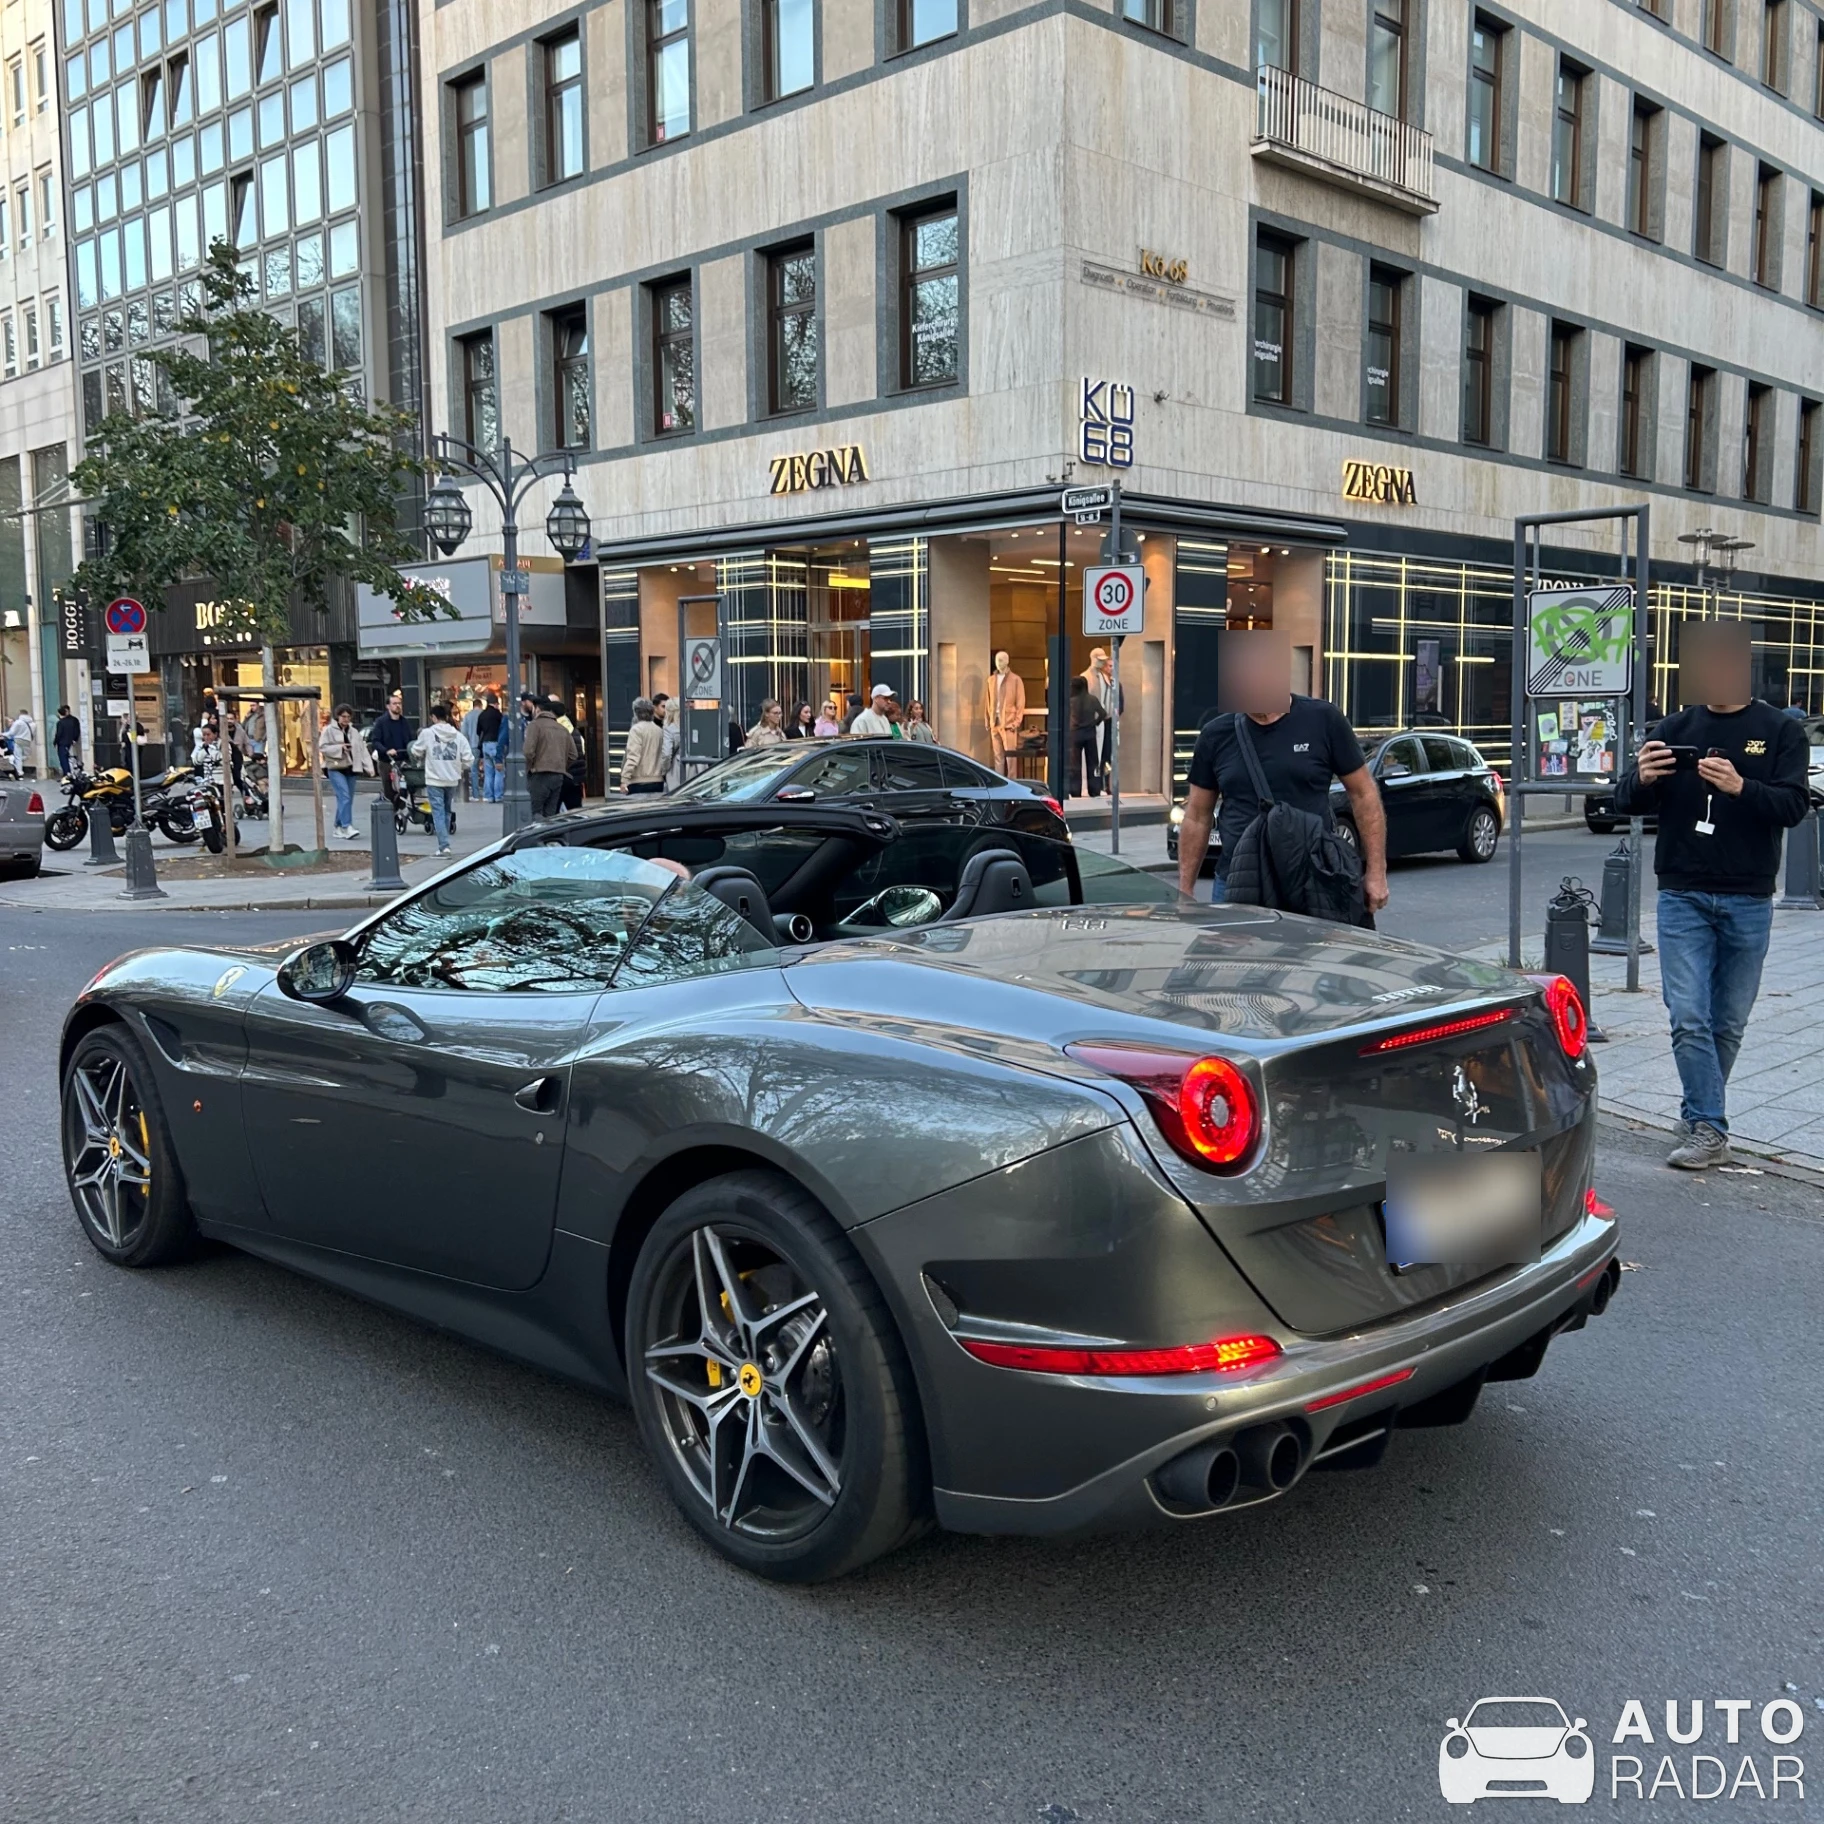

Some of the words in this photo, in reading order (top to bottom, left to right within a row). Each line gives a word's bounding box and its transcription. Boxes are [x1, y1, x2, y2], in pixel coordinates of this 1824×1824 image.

[1140, 248, 1165, 278] Kö
[1169, 257, 1189, 283] 68
[1126, 278, 1156, 294] Operation
[1080, 421, 1134, 468] 68
[768, 445, 869, 495] ZEGNA
[1345, 461, 1419, 505] ZEGNA
[1068, 493, 1105, 507] Königsallee
[1102, 583, 1126, 605] 30
[64, 600, 79, 650] BOGGI
[1098, 618, 1129, 631] ZONE
[1552, 670, 1603, 688] ZONE
[694, 686, 713, 696] ZONE
[1293, 743, 1310, 752] EA7
